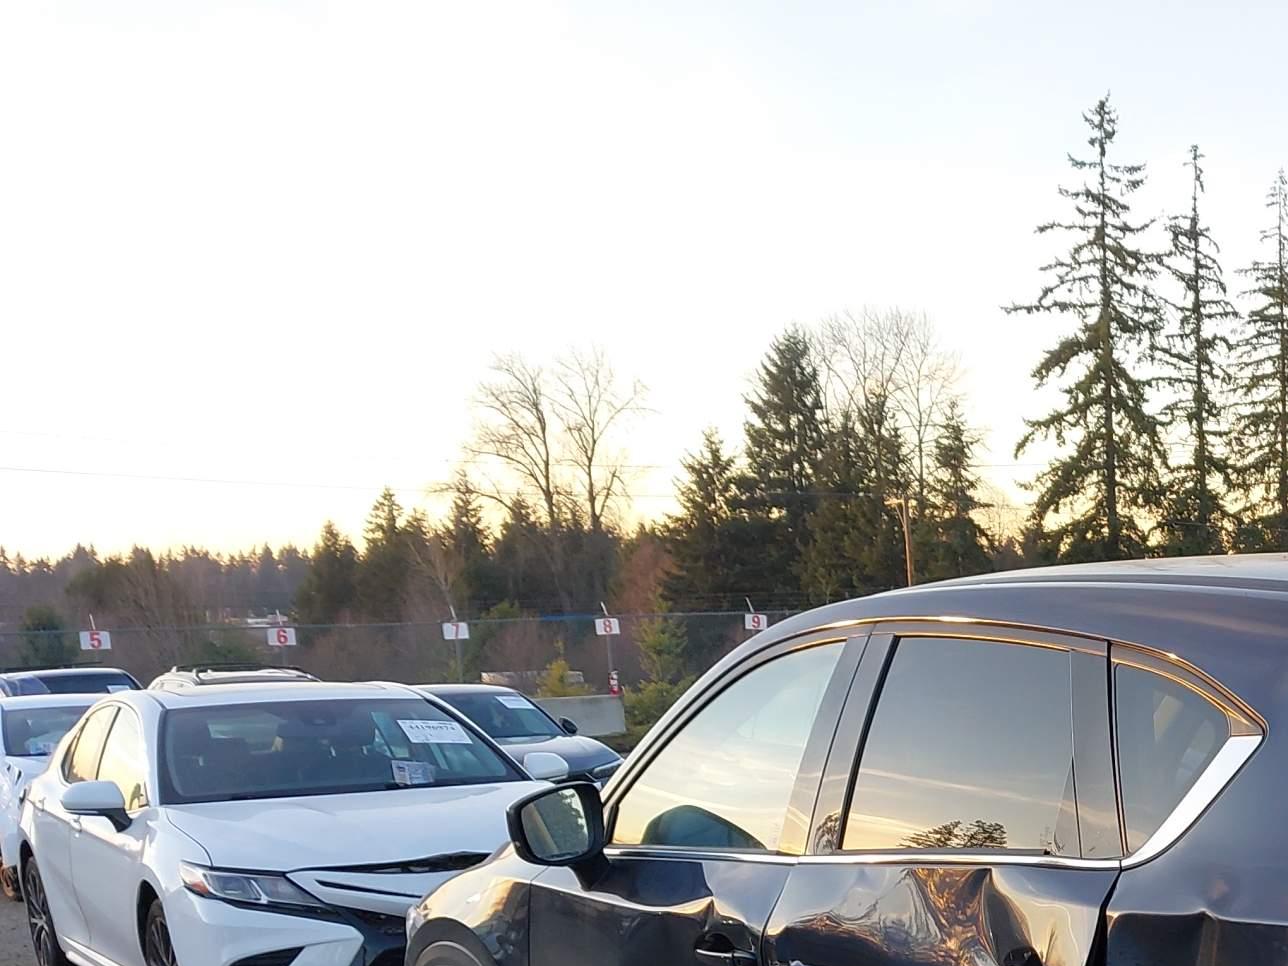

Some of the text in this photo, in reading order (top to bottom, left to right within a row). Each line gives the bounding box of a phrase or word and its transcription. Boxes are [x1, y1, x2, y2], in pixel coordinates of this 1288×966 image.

[603, 619, 612, 633] 8
[752, 615, 760, 628] 9
[277, 628, 288, 645] 6
[451, 623, 459, 639] 7
[89, 631, 100, 648] 5
